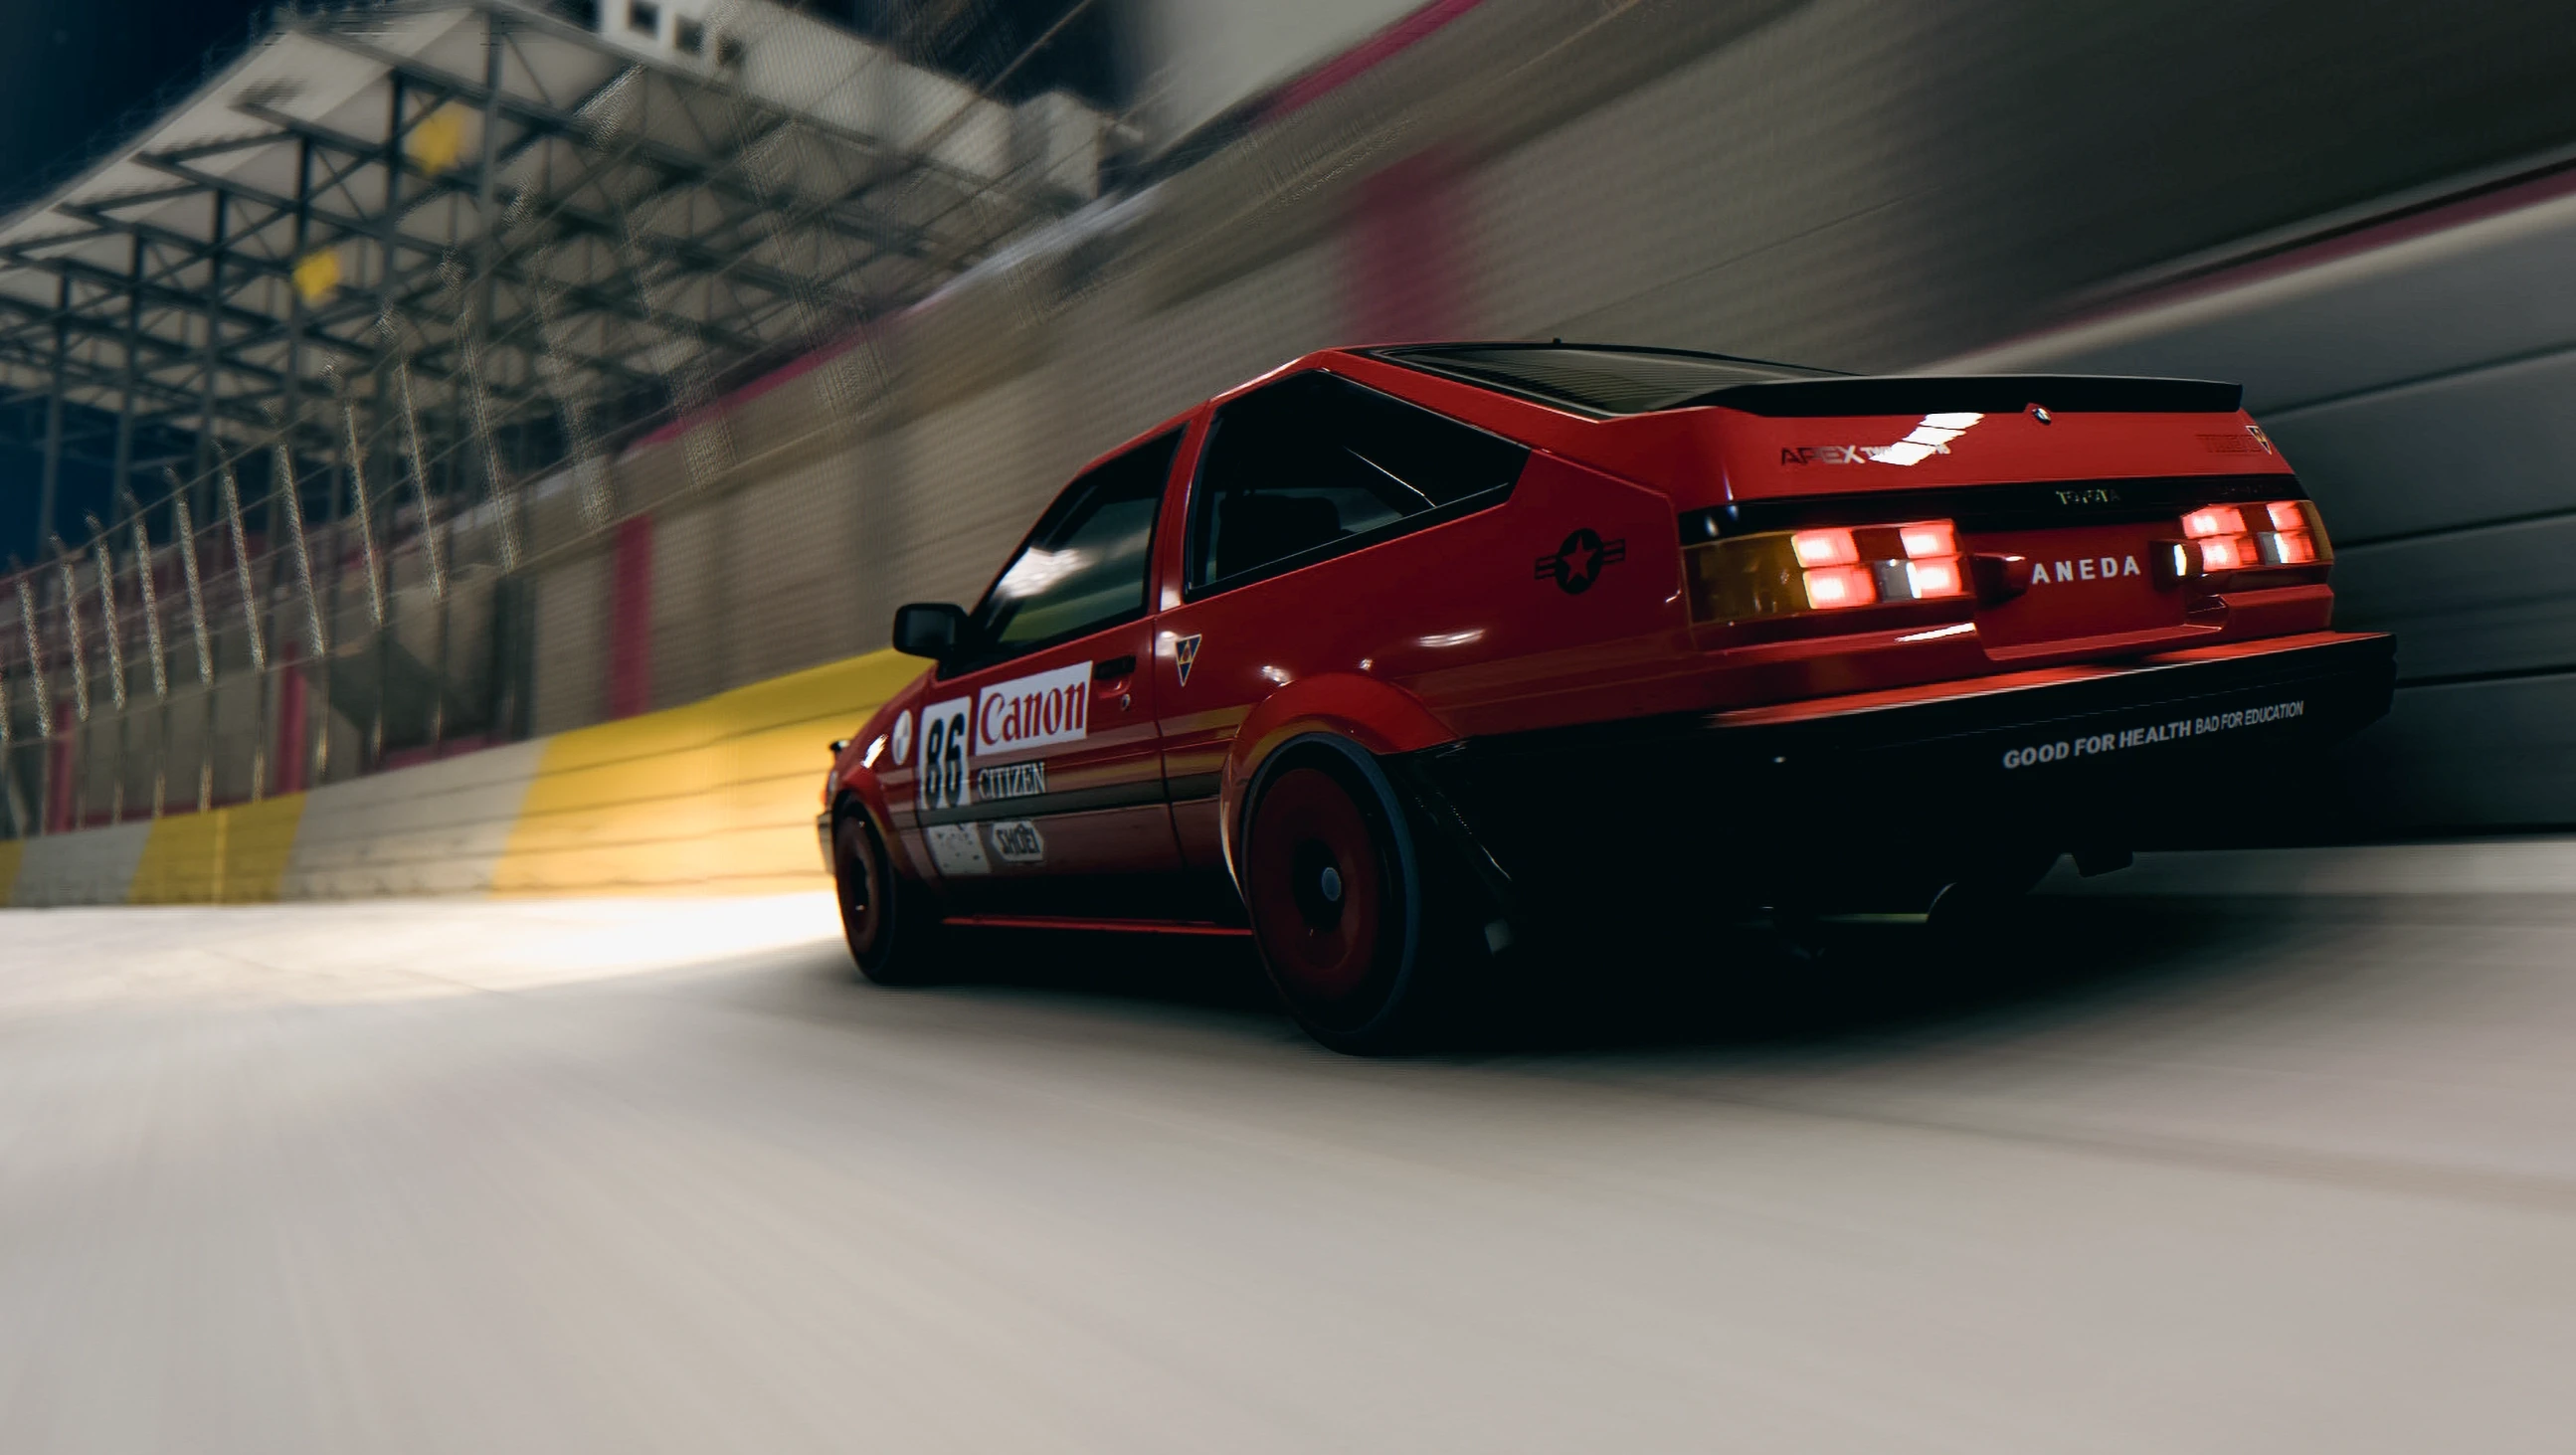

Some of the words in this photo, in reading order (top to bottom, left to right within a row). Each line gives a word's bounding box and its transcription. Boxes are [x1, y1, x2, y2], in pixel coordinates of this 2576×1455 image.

[1781, 445, 1866, 465] APEX
[2031, 555, 2141, 585] ANEDA
[980, 681, 1086, 746] Canon
[2003, 741, 2070, 769] GOOD
[2074, 733, 2115, 757] FOR
[2118, 720, 2192, 748] HEALTH
[2195, 714, 2219, 735] BAD
[2221, 710, 2243, 730] FOR
[2245, 700, 2304, 725] EDUCATION
[925, 712, 966, 811] 86
[978, 762, 1047, 800] CITIZEN
